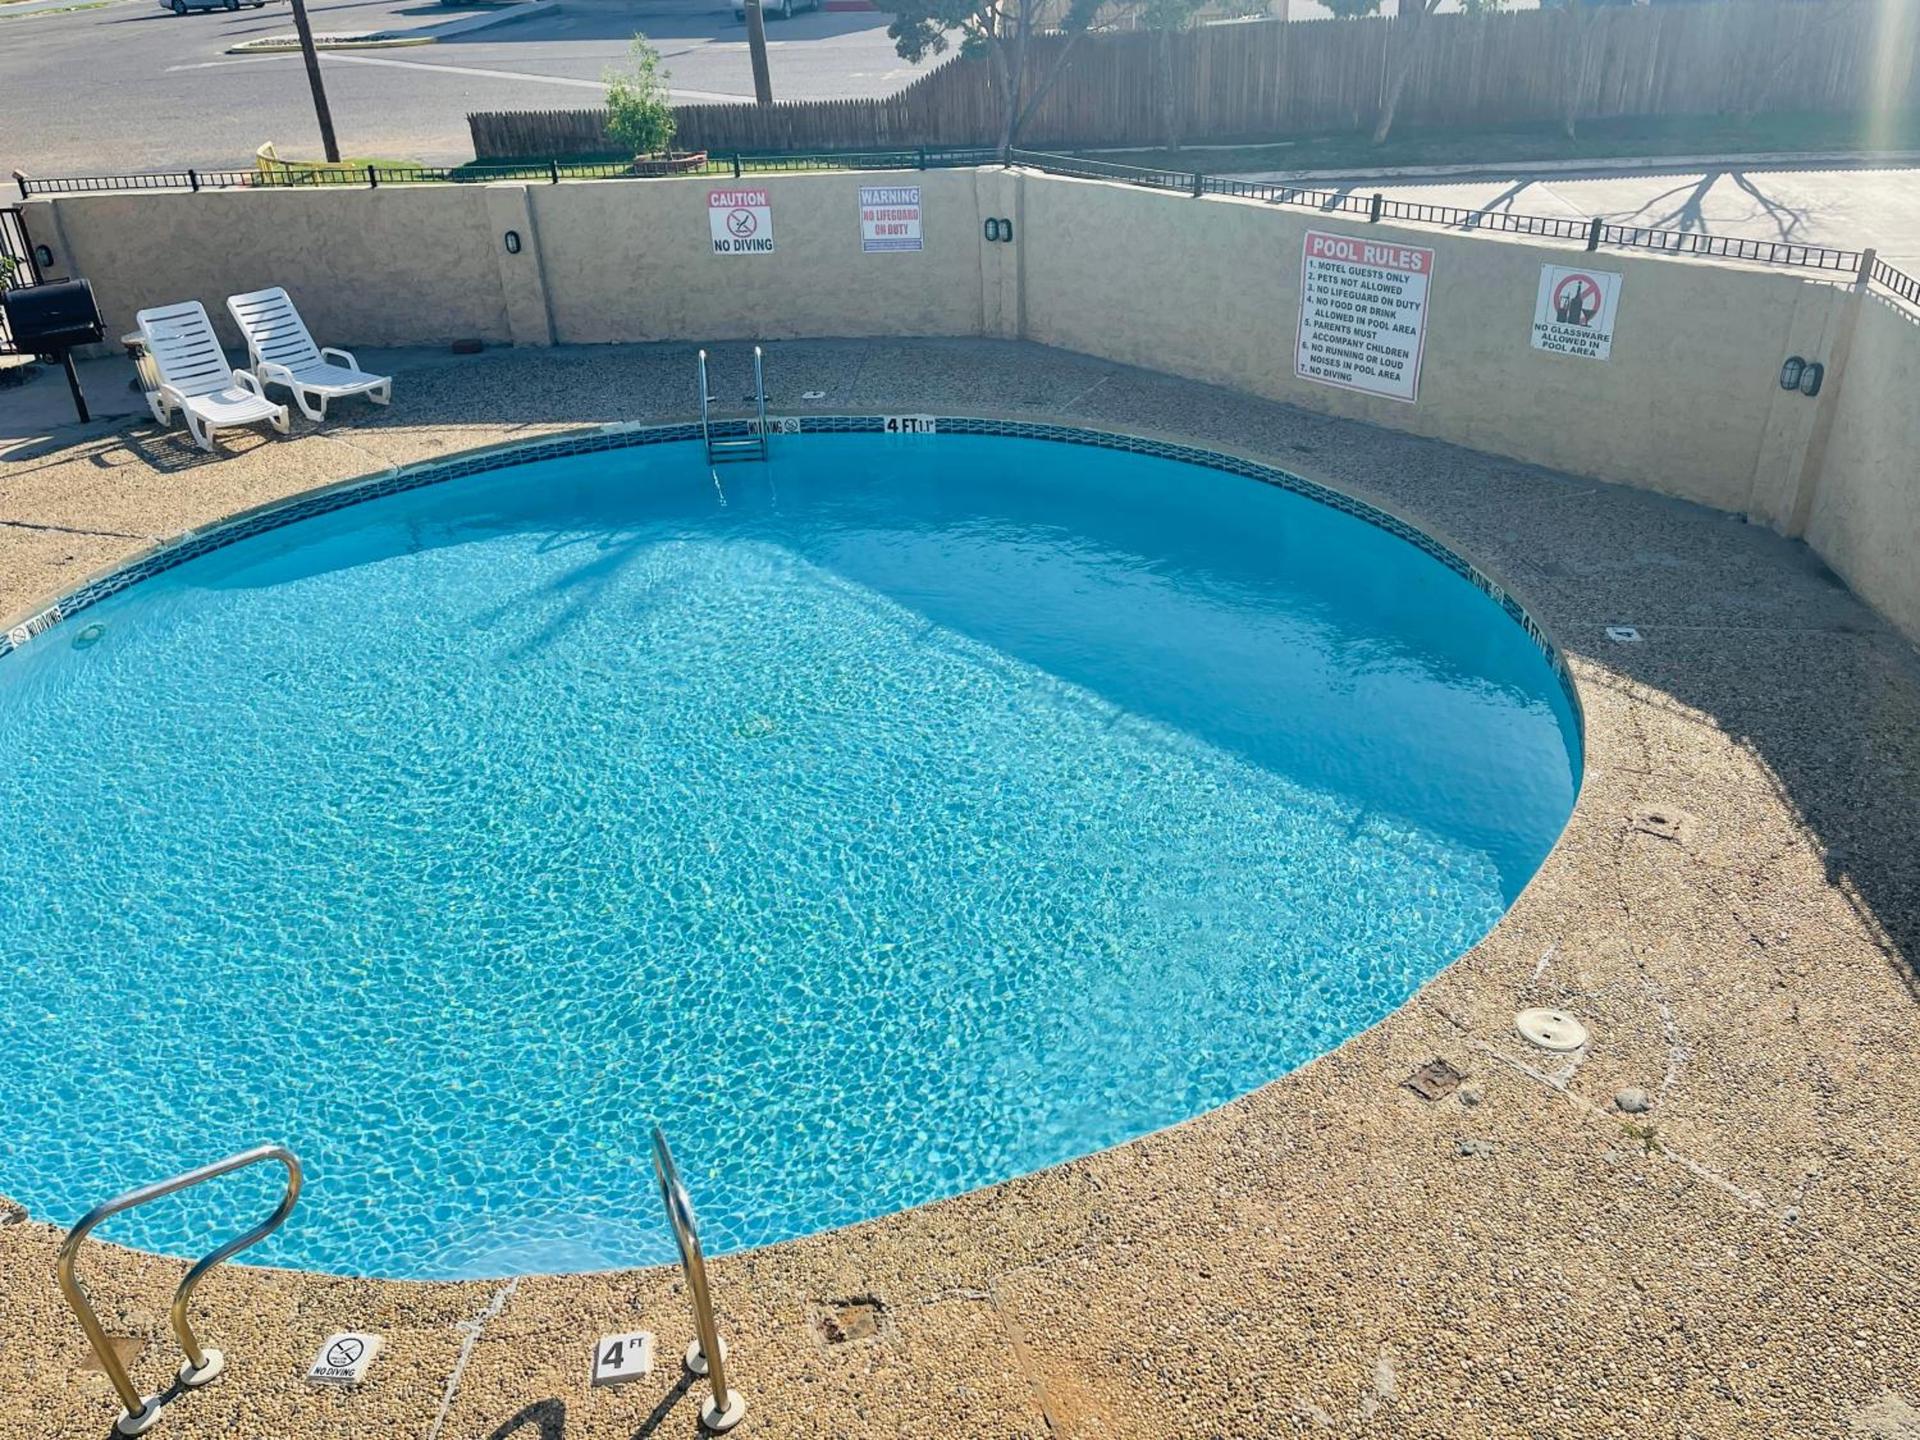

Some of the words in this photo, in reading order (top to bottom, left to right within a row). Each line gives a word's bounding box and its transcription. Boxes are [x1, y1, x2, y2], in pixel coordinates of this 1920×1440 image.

[711, 192, 766, 206] CAUTION
[861, 189, 919, 205] WARNING
[863, 209, 874, 221] NO
[876, 208, 919, 221] LIFEGUARD
[875, 224, 886, 235] ON
[887, 223, 908, 235] DUTY
[714, 239, 730, 251] NO
[734, 238, 773, 251] DIVING
[1313, 238, 1358, 260] POOL
[1363, 245, 1423, 270] RULES
[1309, 260, 1316, 269] 1.
[1318, 261, 1346, 274] MOTEL
[1348, 266, 1384, 280] GUESTS
[1386, 272, 1411, 284] ONLY
[1308, 271, 1315, 280] 2.
[1317, 273, 1338, 285] PETS
[1340, 277, 1358, 288] NOT
[1360, 280, 1403, 295] ALLOWED
[1306, 295, 1314, 304] 4.
[1316, 296, 1329, 306] NO
[1330, 298, 1353, 311] FOOD
[1355, 304, 1368, 314] OR
[1369, 306, 1397, 320] DRINK
[1316, 285, 1329, 295] NO
[1331, 287, 1380, 303] LIFEGUARD
[1381, 296, 1394, 307] ON
[1396, 299, 1422, 311] DUTY
[1313, 320, 1352, 335] PARENTS
[1353, 327, 1378, 340] MUST
[1315, 308, 1354, 323] ALLOWED
[1356, 316, 1366, 326] IN
[1367, 319, 1390, 331] POOL
[1391, 323, 1417, 336] AREA
[1534, 323, 1549, 332] NO
[1550, 325, 1610, 343] GLASSWARE
[1541, 332, 1587, 347] ALLOWED
[1589, 340, 1601, 349] IN
[1312, 332, 1365, 348] ACCOMPANY
[1366, 342, 1410, 359] CHILDREN
[1542, 341, 1567, 352] POOL
[1570, 346, 1596, 357] AREA
[1311, 343, 1324, 353] NO
[1325, 346, 1365, 361] RUNNING
[1366, 355, 1379, 365] OR
[1380, 357, 1404, 370] LOUD
[1309, 365, 1322, 375] NO
[1323, 368, 1353, 382] DIVING
[1310, 354, 1341, 368] NOISES
[1343, 361, 1353, 371] IN
[1353, 363, 1376, 376] POOL
[1378, 369, 1401, 382] AREA
[887, 417, 899, 432] 4
[601, 1341, 624, 1369] 4
[630, 1337, 644, 1349] FT
[313, 1366, 326, 1376] NO
[326, 1367, 356, 1377] DIVING
